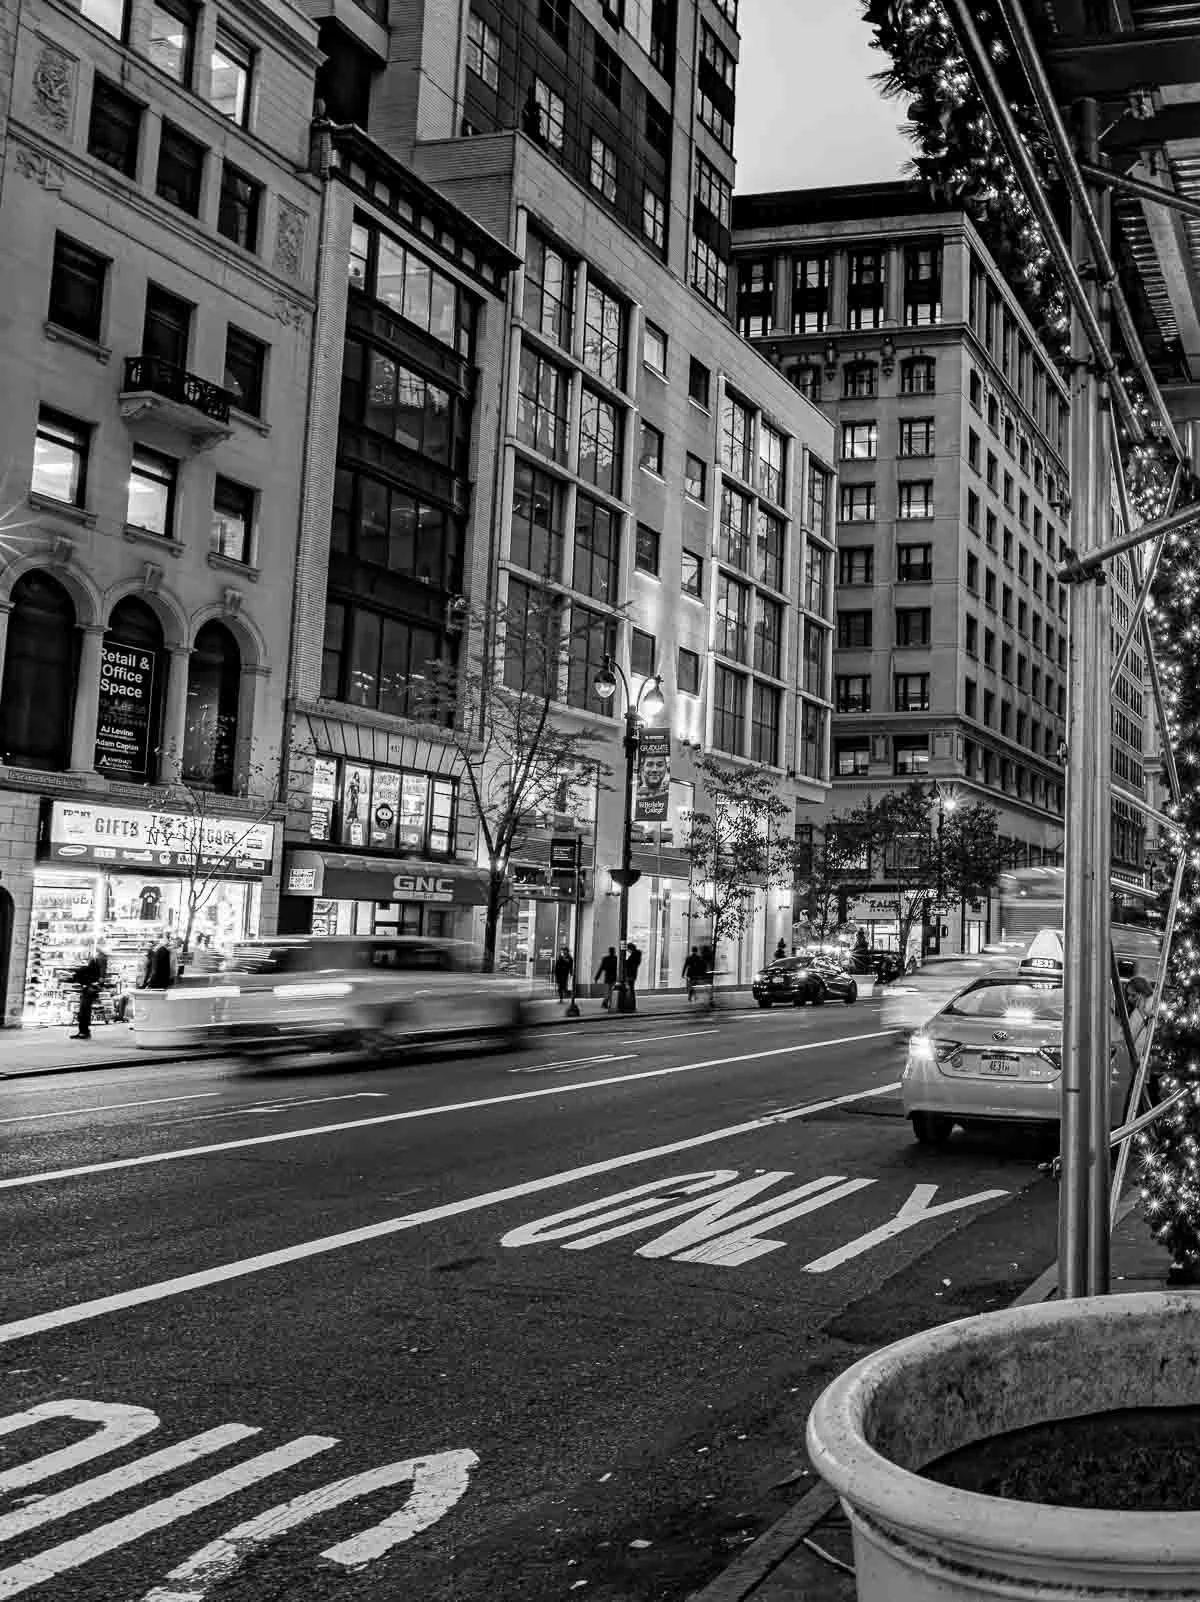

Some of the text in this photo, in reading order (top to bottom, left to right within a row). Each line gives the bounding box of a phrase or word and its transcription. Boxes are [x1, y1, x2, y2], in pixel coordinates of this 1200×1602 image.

[100, 648, 150, 671] Retail &
[102, 663, 143, 683] Office
[100, 678, 143, 698] Space
[111, 727, 134, 737] Levine
[96, 738, 115, 748] Adam
[640, 744, 669, 753] GRADUATE
[95, 817, 139, 838] GIFTS
[393, 874, 455, 893] GNC
[500, 1169, 1011, 1273] ONLY
